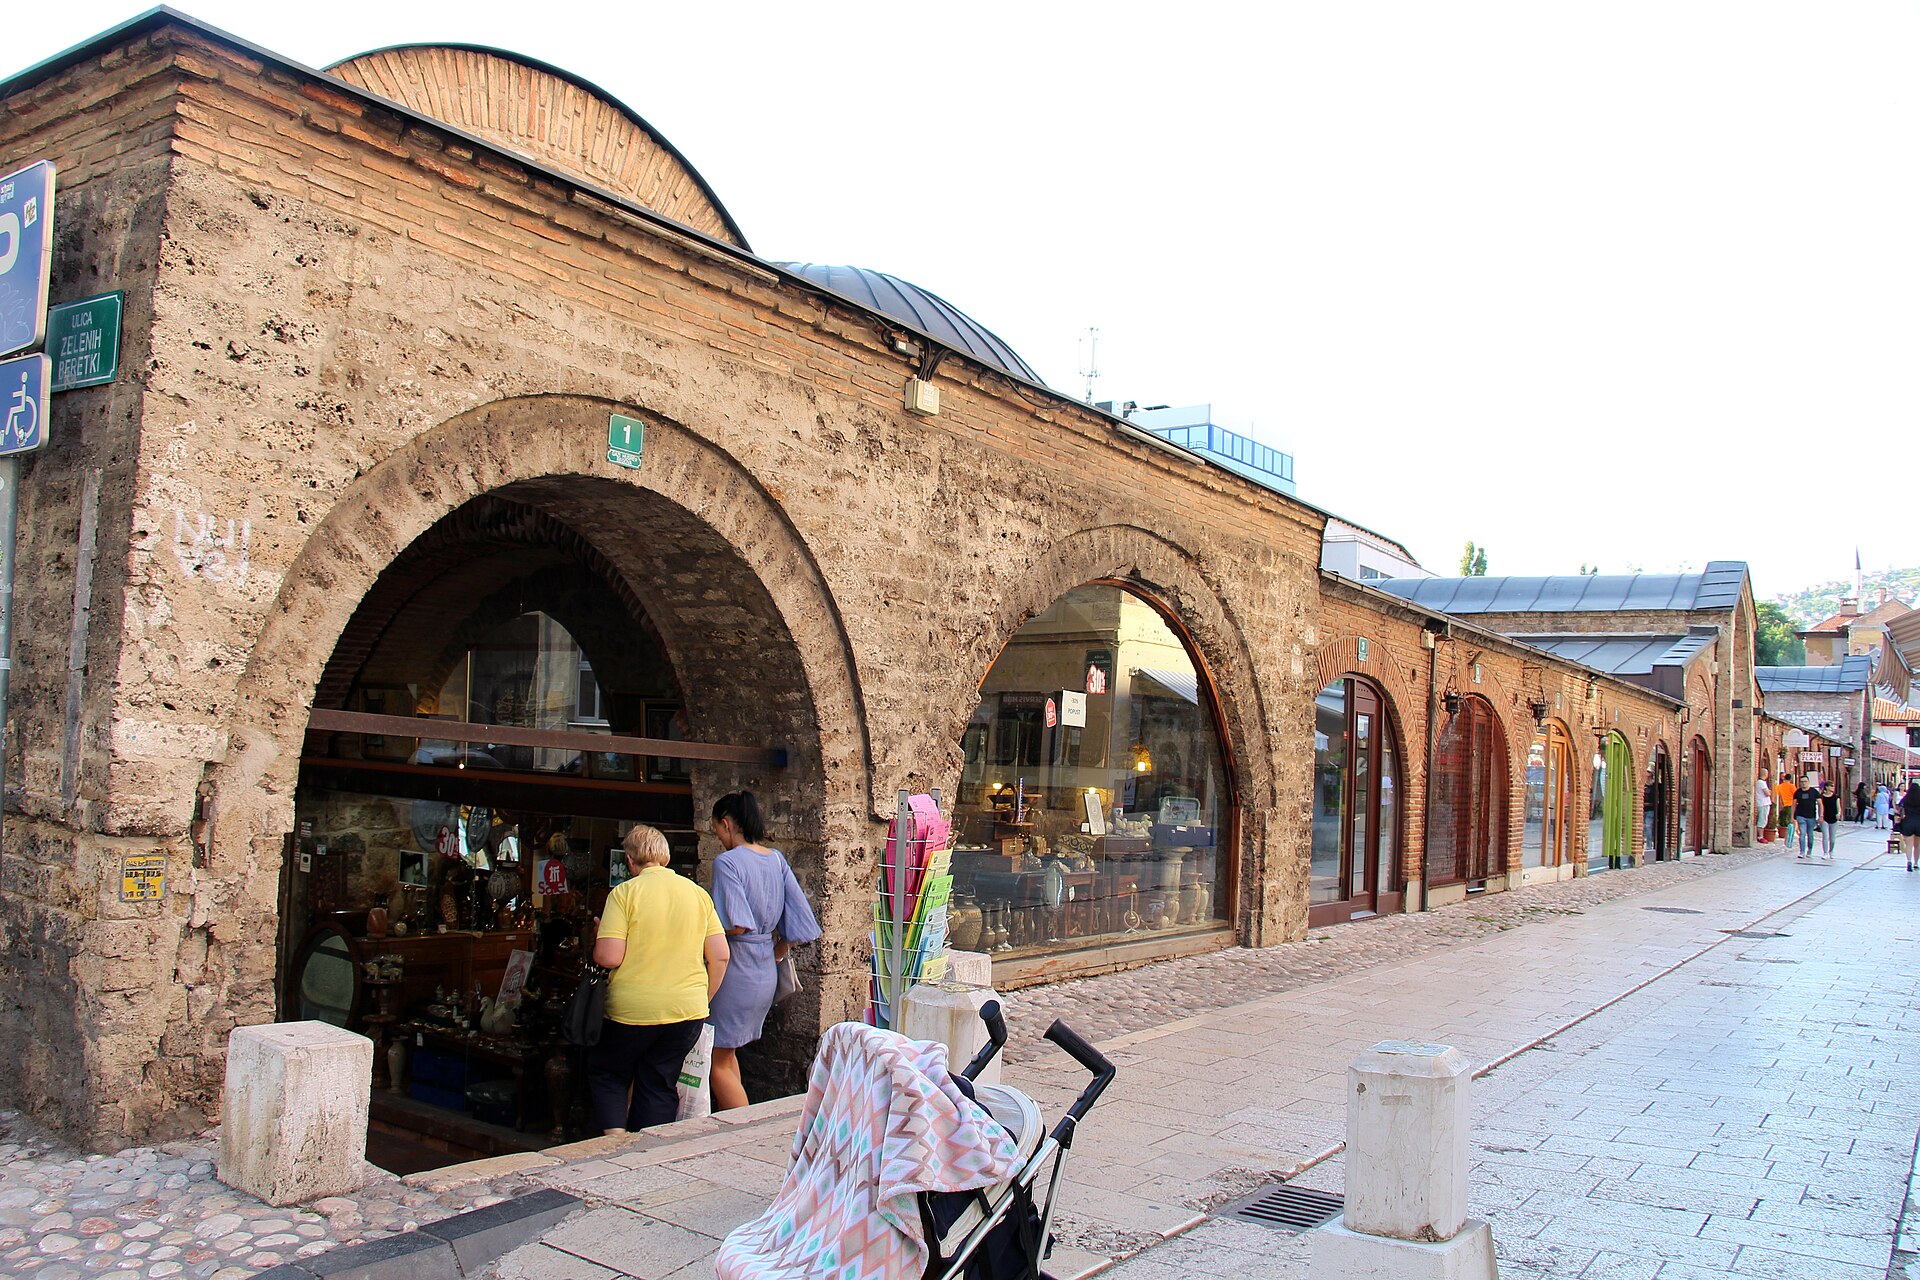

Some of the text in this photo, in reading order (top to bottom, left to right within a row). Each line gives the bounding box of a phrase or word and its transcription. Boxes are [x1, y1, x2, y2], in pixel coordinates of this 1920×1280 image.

[72, 311, 93, 328] ULICA
[61, 329, 102, 356] ZELENIH
[58, 352, 101, 380] BERETKI
[623, 424, 631, 444] 1
